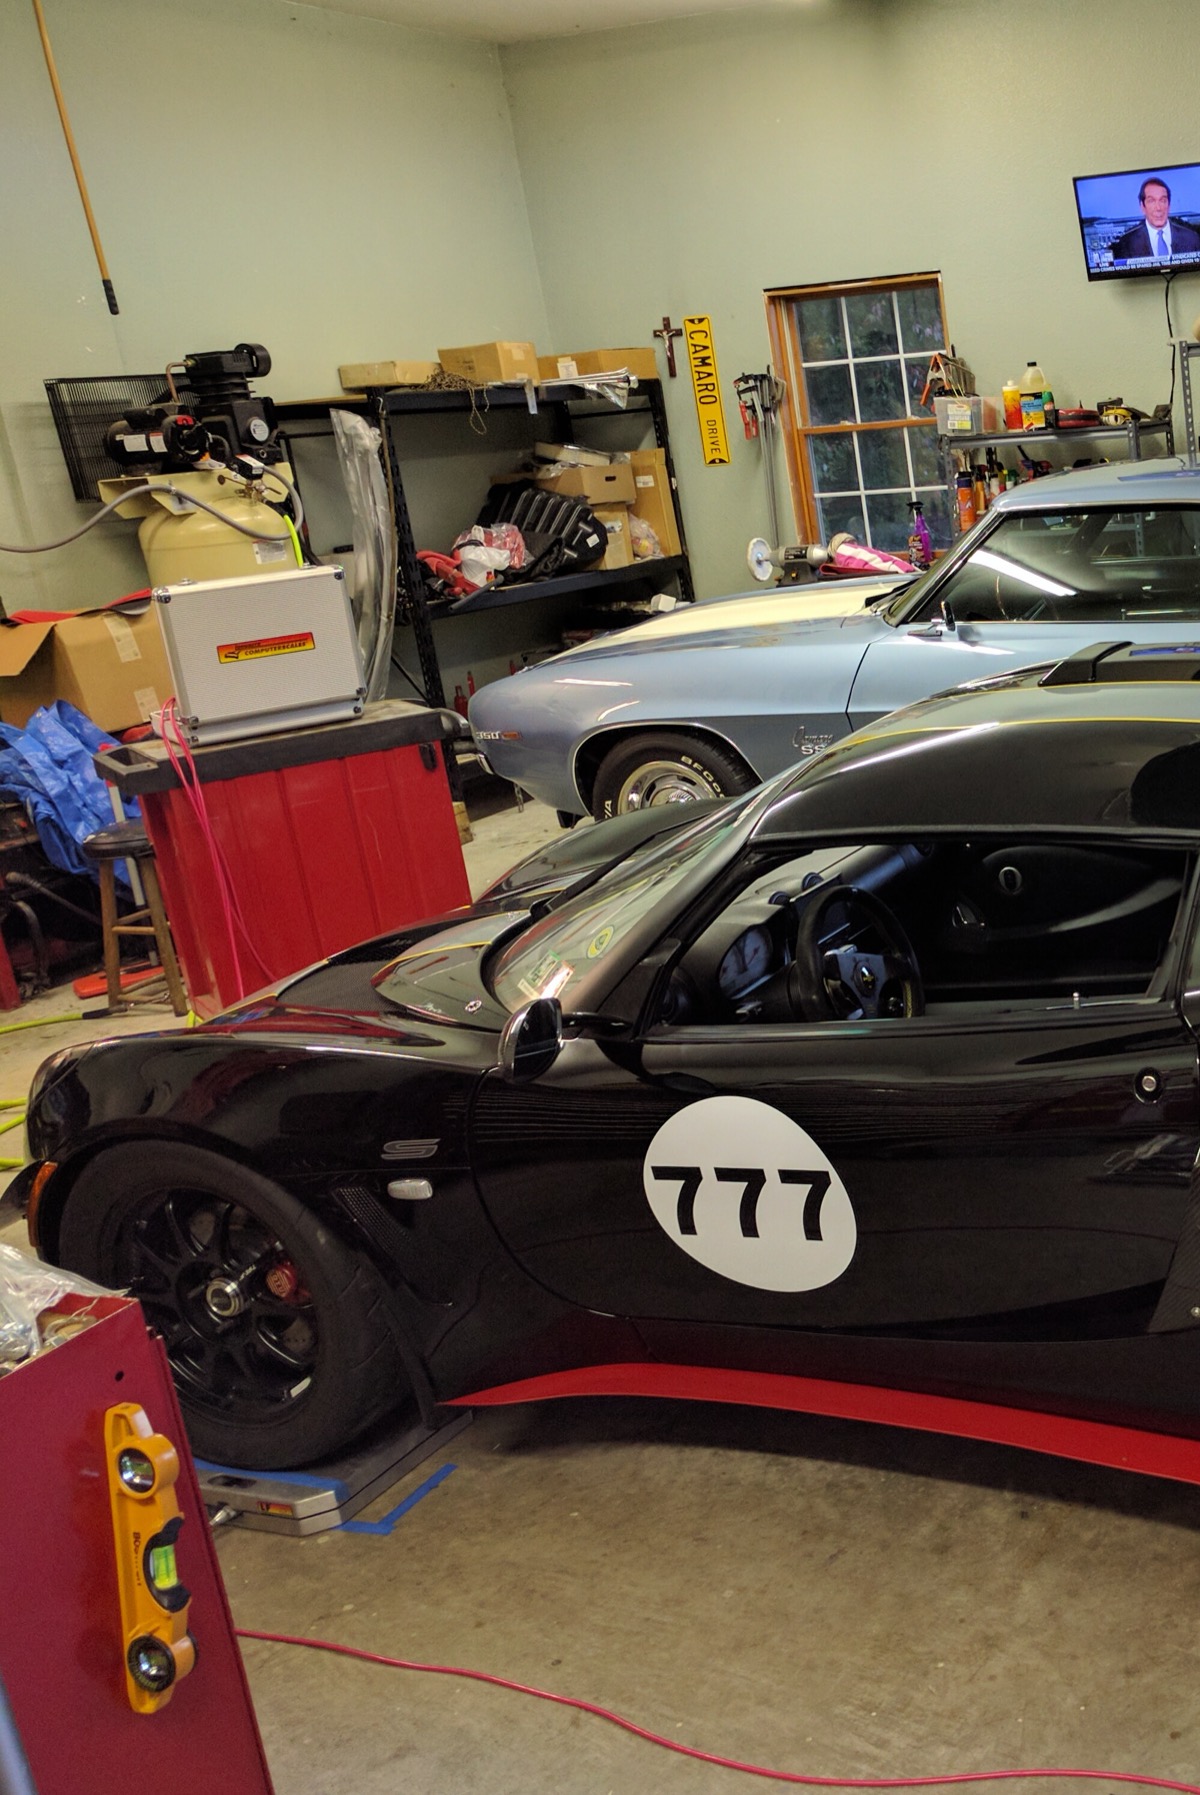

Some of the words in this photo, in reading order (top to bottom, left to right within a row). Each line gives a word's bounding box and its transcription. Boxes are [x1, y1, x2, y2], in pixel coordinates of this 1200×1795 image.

[689, 330, 717, 404] CAMARO
[706, 419, 721, 454] DRIVE
[476, 731, 500, 740] 350
[650, 1166, 832, 1242] 777
